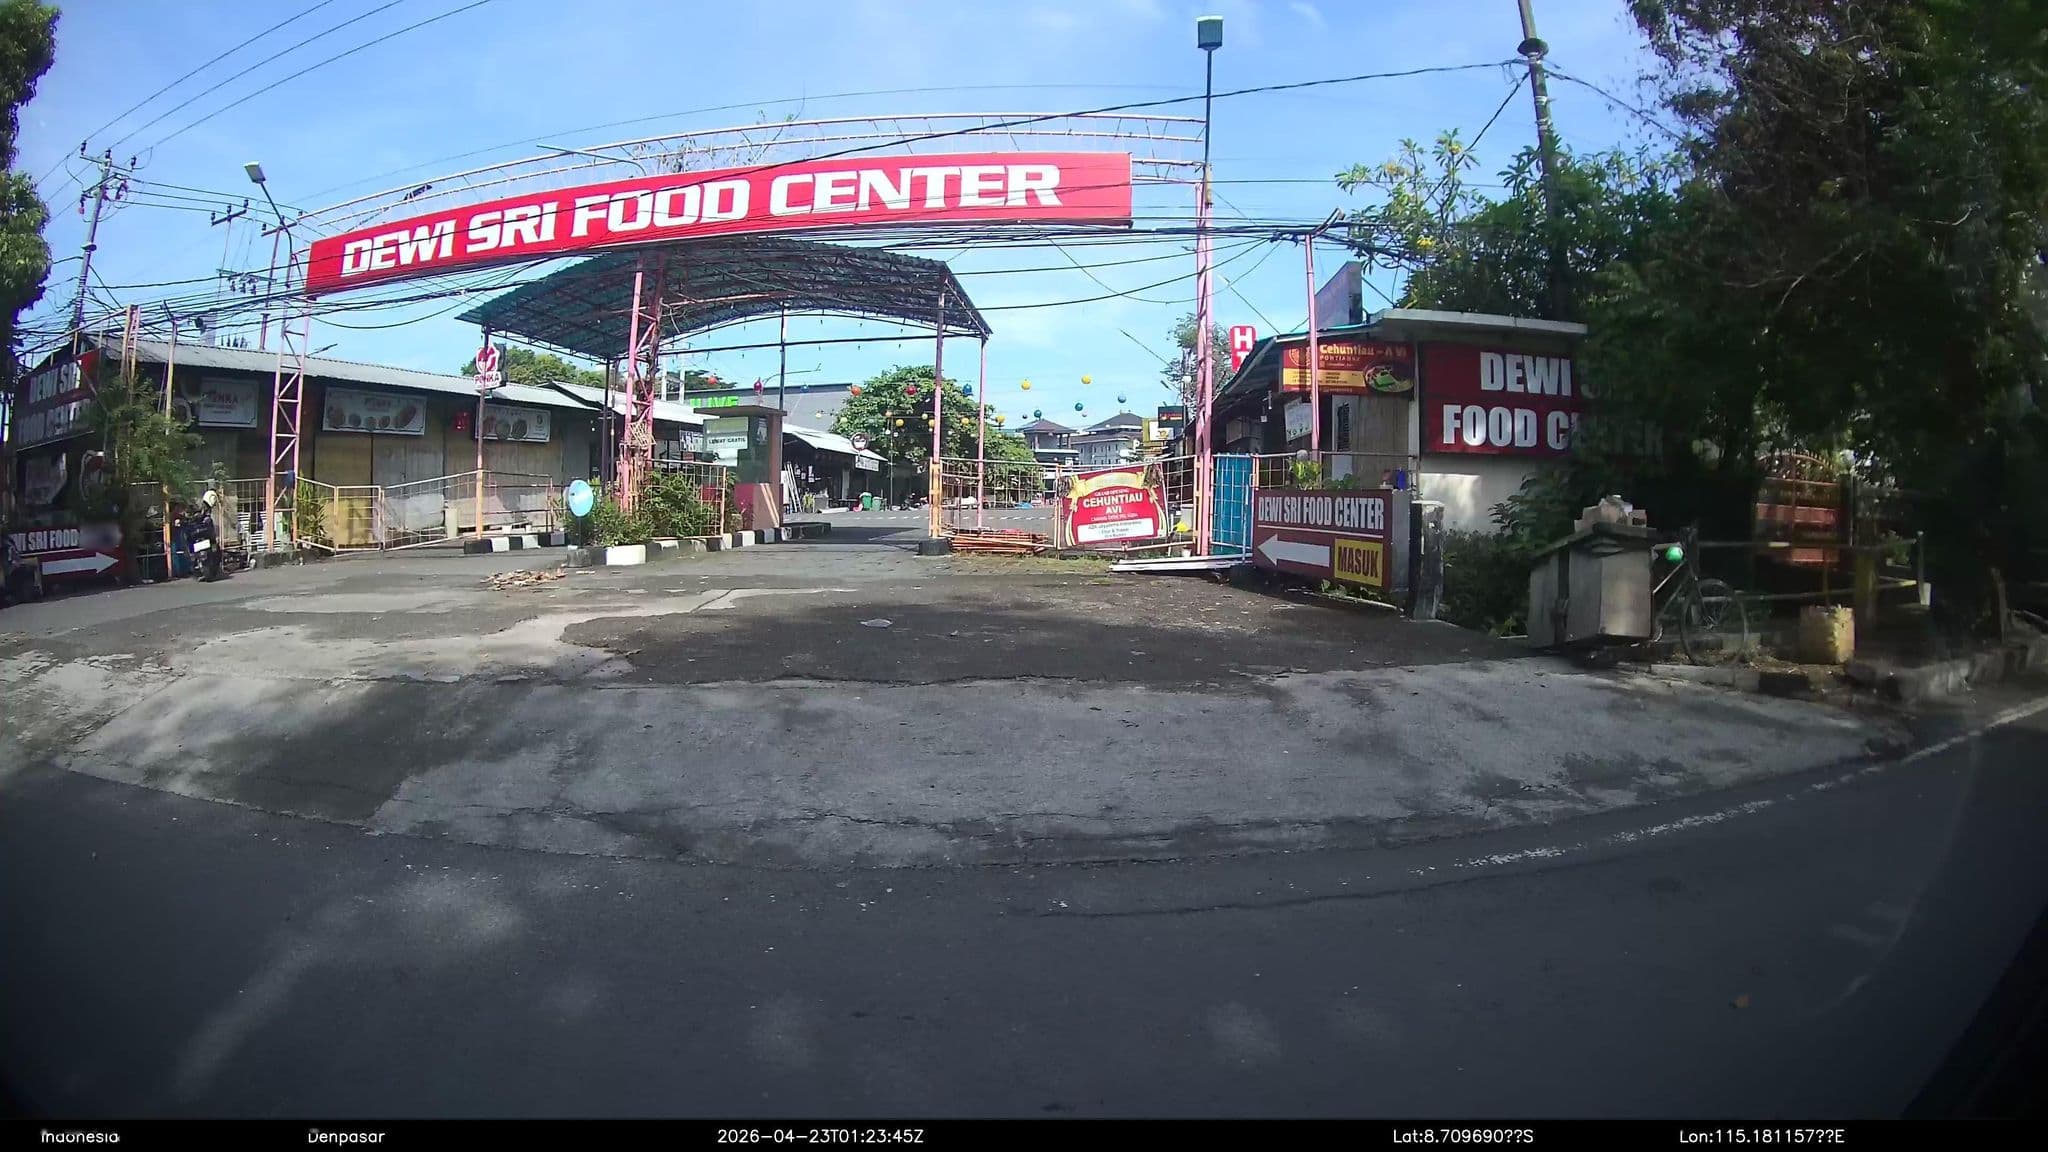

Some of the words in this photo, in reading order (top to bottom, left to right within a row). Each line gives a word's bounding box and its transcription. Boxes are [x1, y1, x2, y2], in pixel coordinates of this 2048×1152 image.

[340, 220, 457, 277] DEWI
[466, 201, 559, 253] SRI
[570, 179, 751, 239] FOOD
[769, 164, 1063, 217] CENTER
[1480, 351, 1572, 397] DEWI
[1443, 404, 1538, 448] FOOD
[1083, 493, 1143, 508] CEHUNTIAU
[1105, 505, 1122, 514] AVI
[1258, 496, 1282, 521] DEWI
[1284, 496, 1301, 524] SRI
[1303, 496, 1332, 526] FOOD
[1335, 497, 1384, 530] CENTER
[28, 531, 48, 550] SRI
[50, 529, 79, 549] FOOD
[1337, 545, 1379, 579] MASUK
